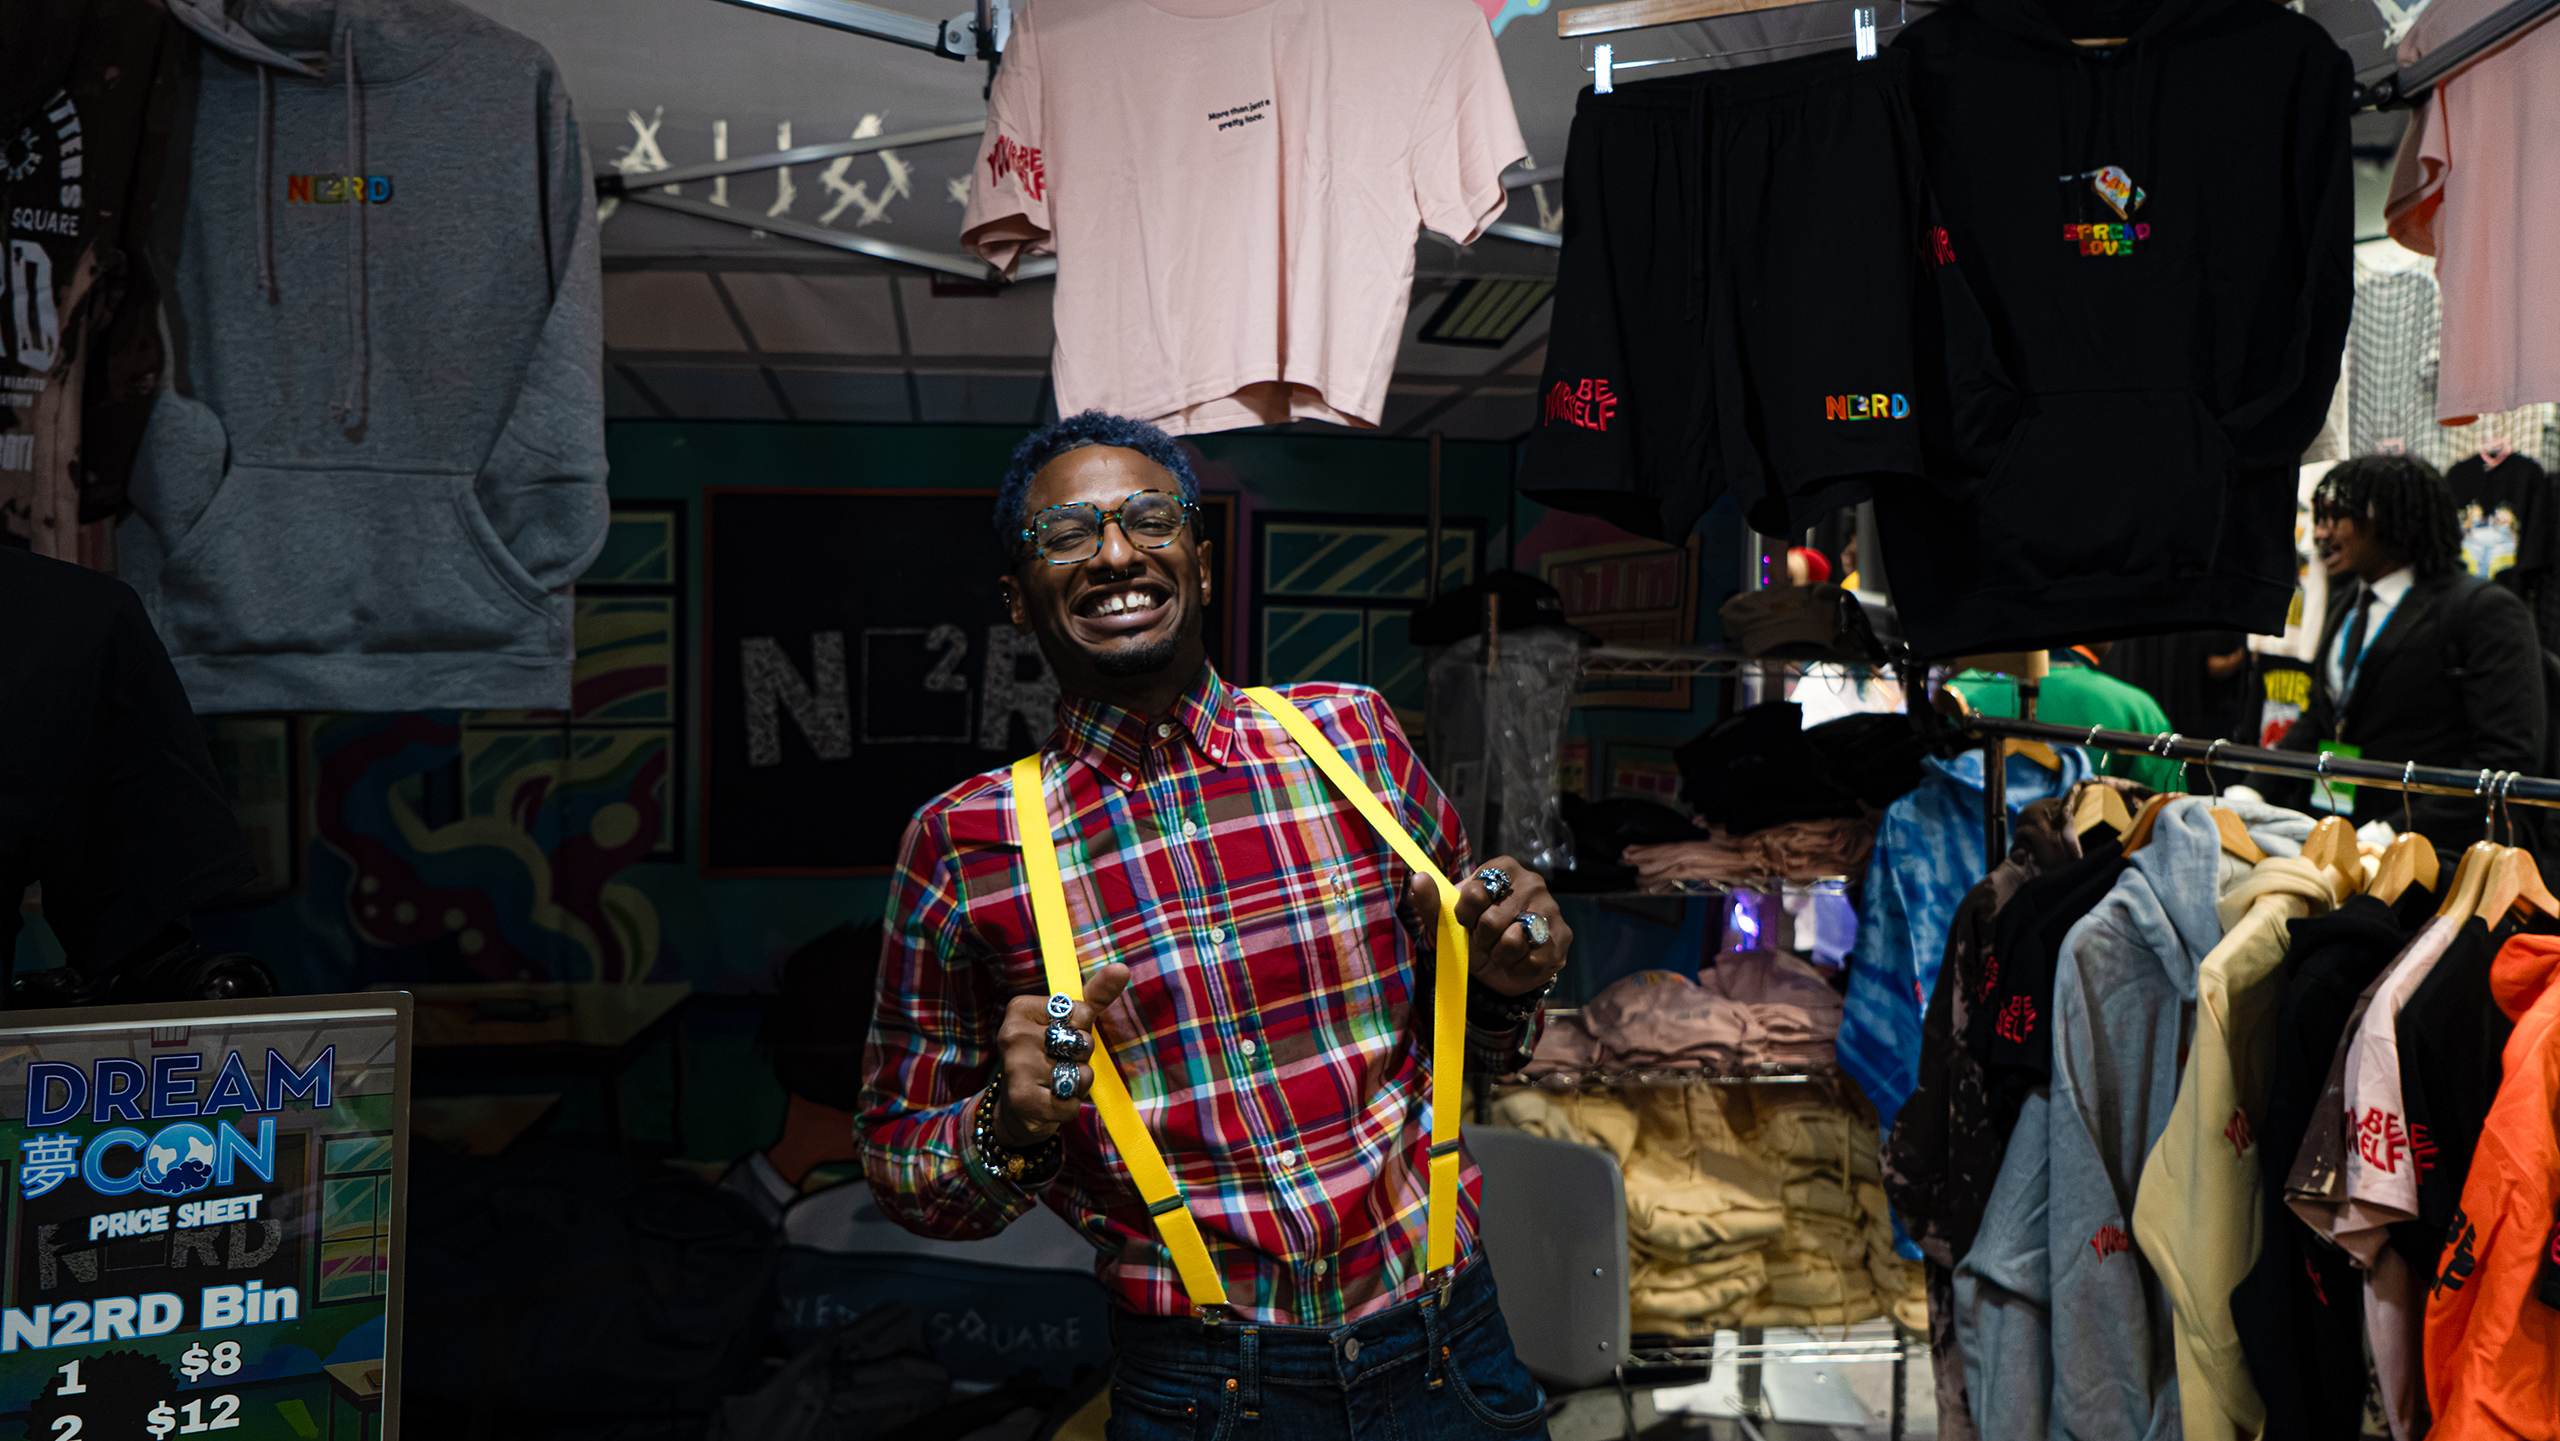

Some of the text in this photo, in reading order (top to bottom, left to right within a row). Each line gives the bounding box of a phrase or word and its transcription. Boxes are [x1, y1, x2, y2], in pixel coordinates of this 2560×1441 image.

[11, 206, 80, 238] SQUARE
[2079, 240, 2133, 256] LOVE
[1574, 378, 1613, 403] BE
[2009, 995, 2035, 1018] BE
[26, 1045, 335, 1128] DREAM
[2361, 1107, 2403, 1141] BE
[20, 1132, 83, 1201] 夢
[82, 1116, 278, 1199] CON
[89, 1194, 263, 1241] PRICE SHEET
[0, 1279, 300, 1353] N2RD Bin
[928, 1309, 1082, 1355] SQUARE
[56, 1340, 243, 1397] 1 $8
[51, 1393, 242, 1441] 2 $12
